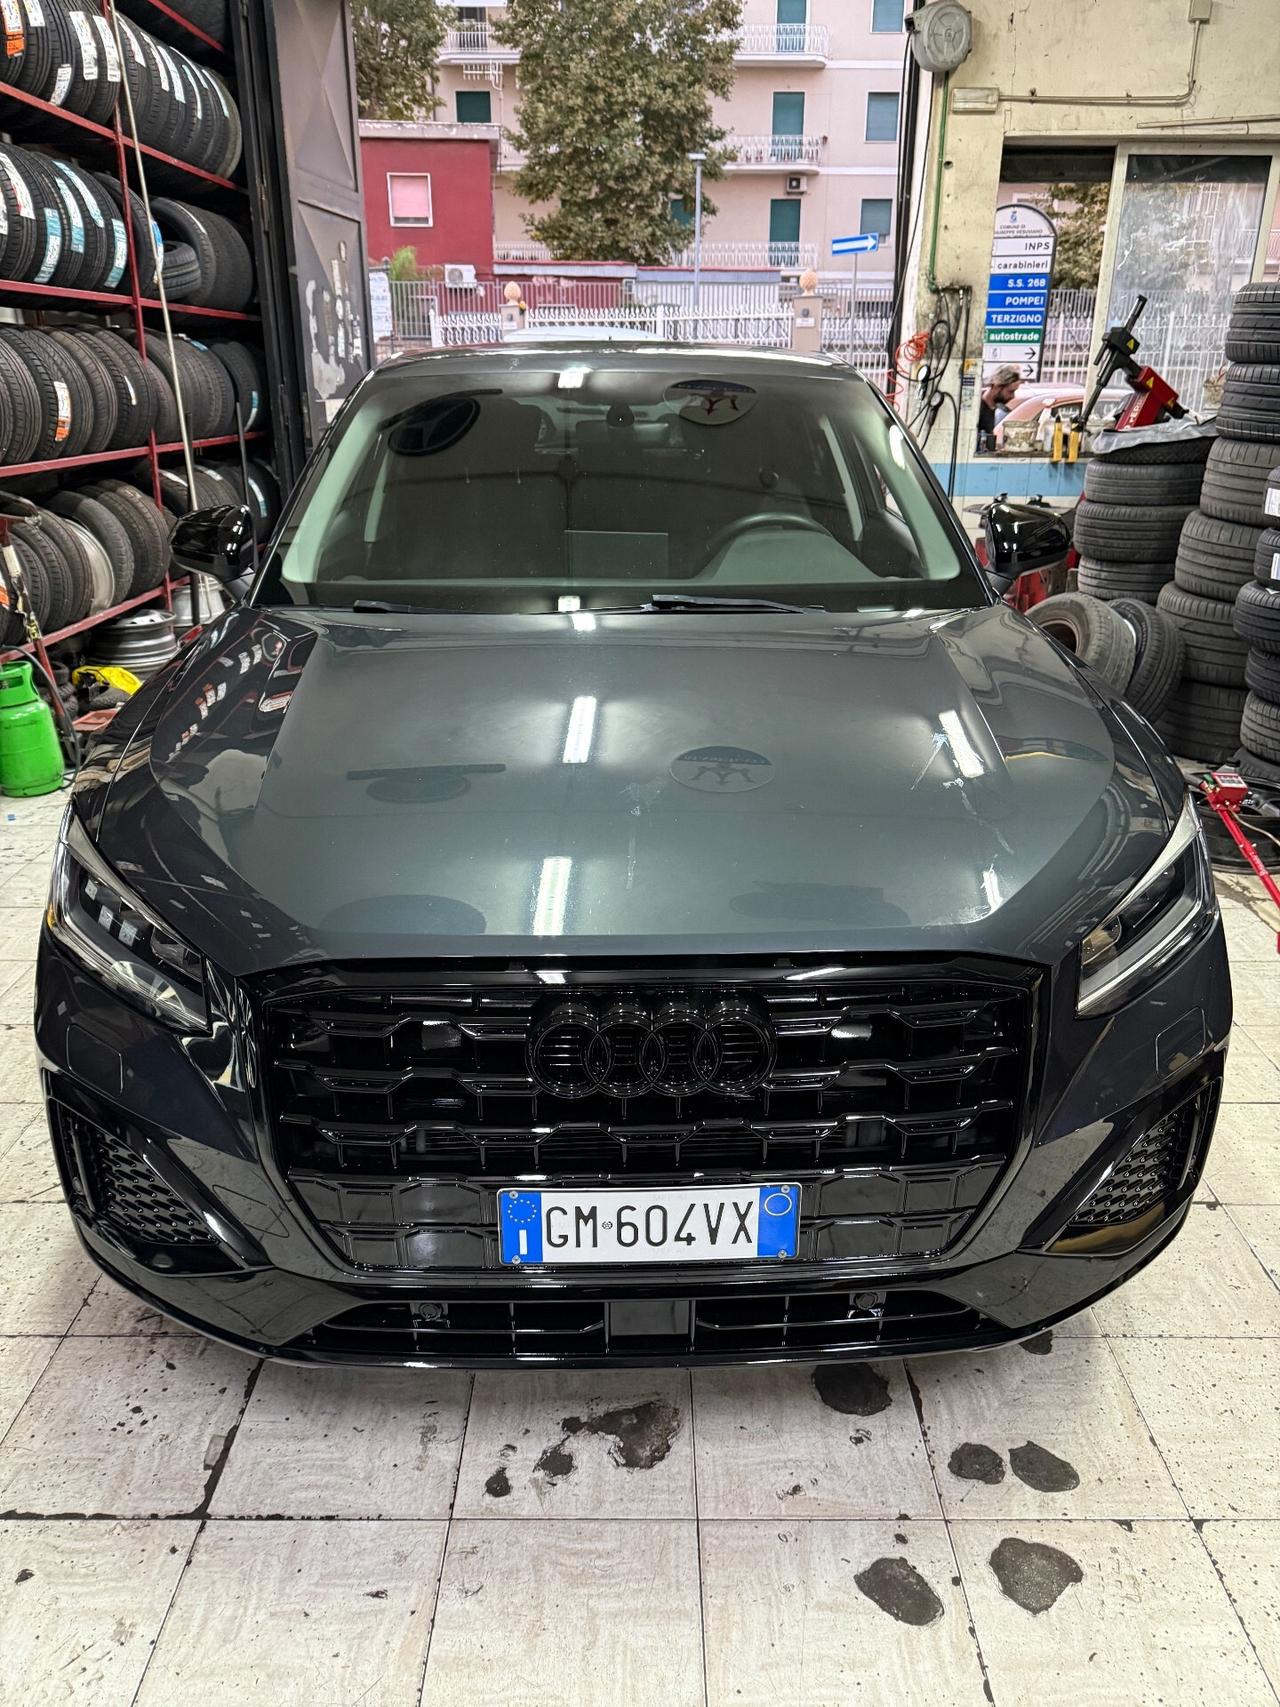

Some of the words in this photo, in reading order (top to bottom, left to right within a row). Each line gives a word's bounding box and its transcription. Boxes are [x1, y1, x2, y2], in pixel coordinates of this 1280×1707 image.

[1024, 242, 1050, 251] INPS
[997, 260, 1048, 270] carabinieri
[1007, 279, 1025, 288] S.S.
[1027, 278, 1046, 287] 268
[1005, 296, 1044, 306] POMPEI
[991, 314, 1042, 324] TERZIGNO
[989, 331, 1040, 341] autostrade
